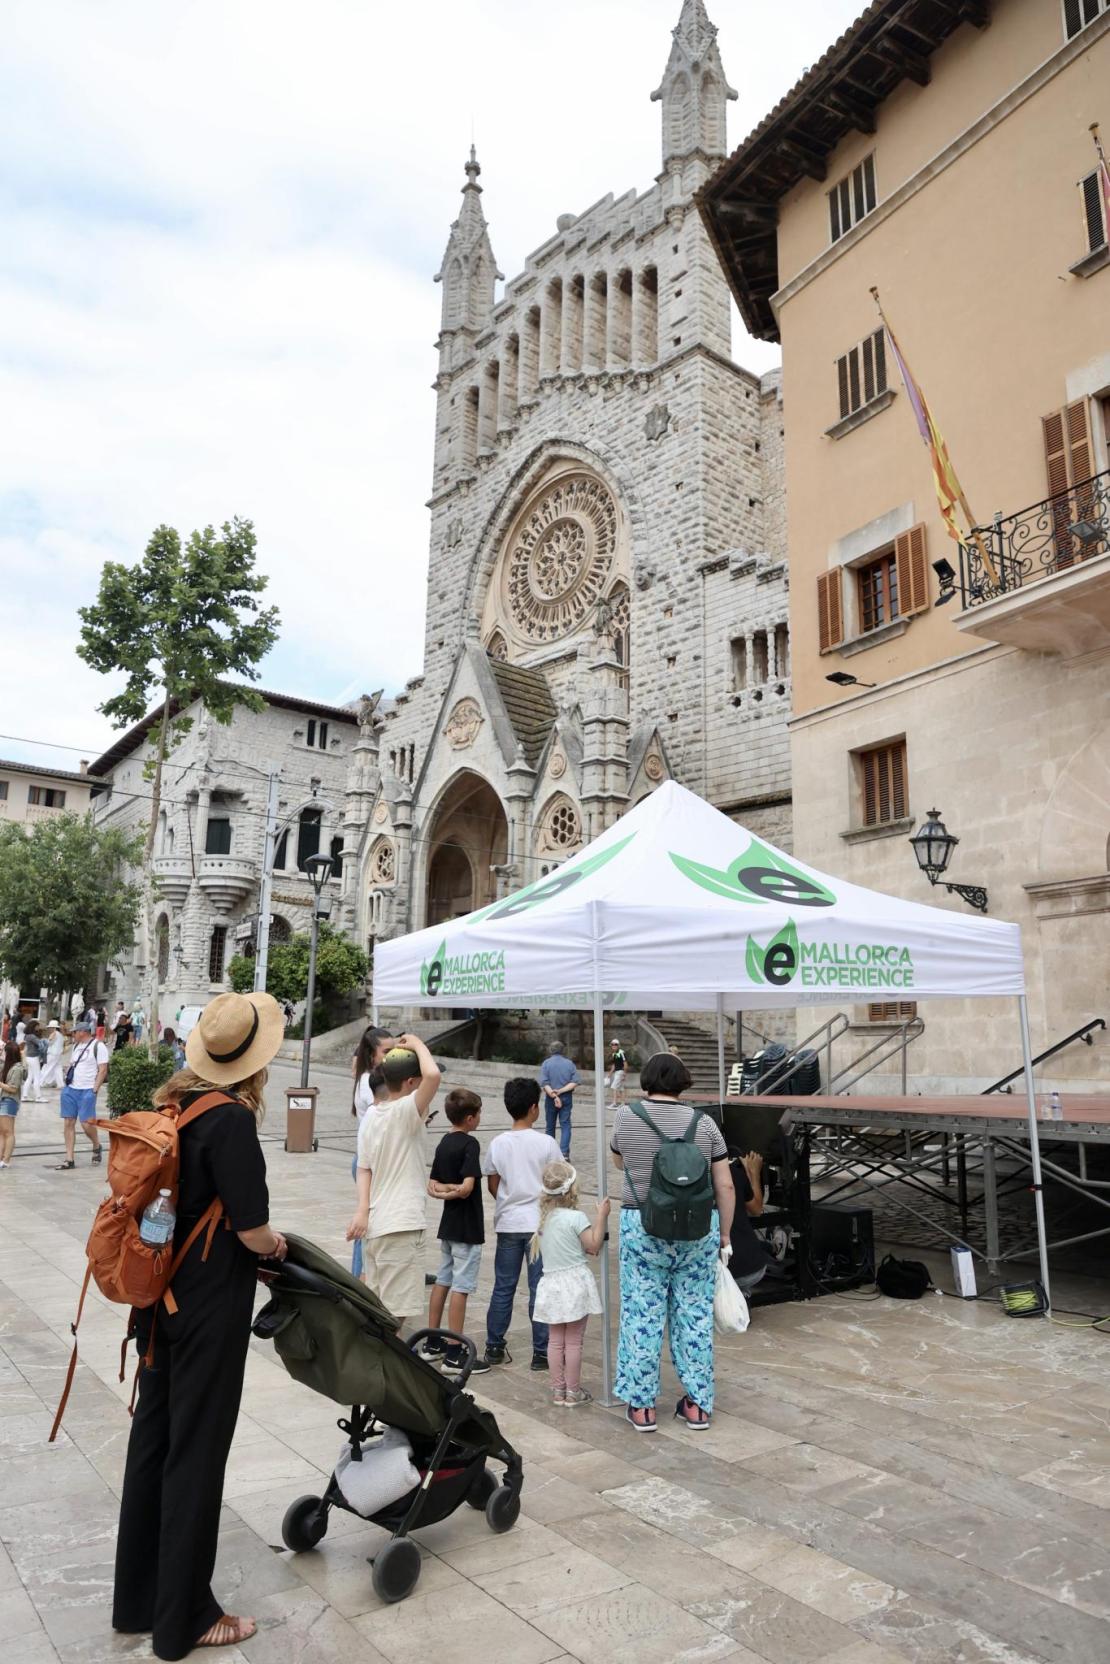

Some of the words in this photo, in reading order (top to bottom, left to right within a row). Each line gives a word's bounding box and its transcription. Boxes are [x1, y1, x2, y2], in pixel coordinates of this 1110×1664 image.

[738, 866, 836, 907] e
[443, 949, 506, 976] MALLORCA
[763, 942, 796, 986] e
[800, 942, 914, 967] MALLORCA
[427, 960, 442, 997] e
[442, 971, 505, 995] EXPERIENCE
[801, 966, 915, 987] EXPERIENCE
